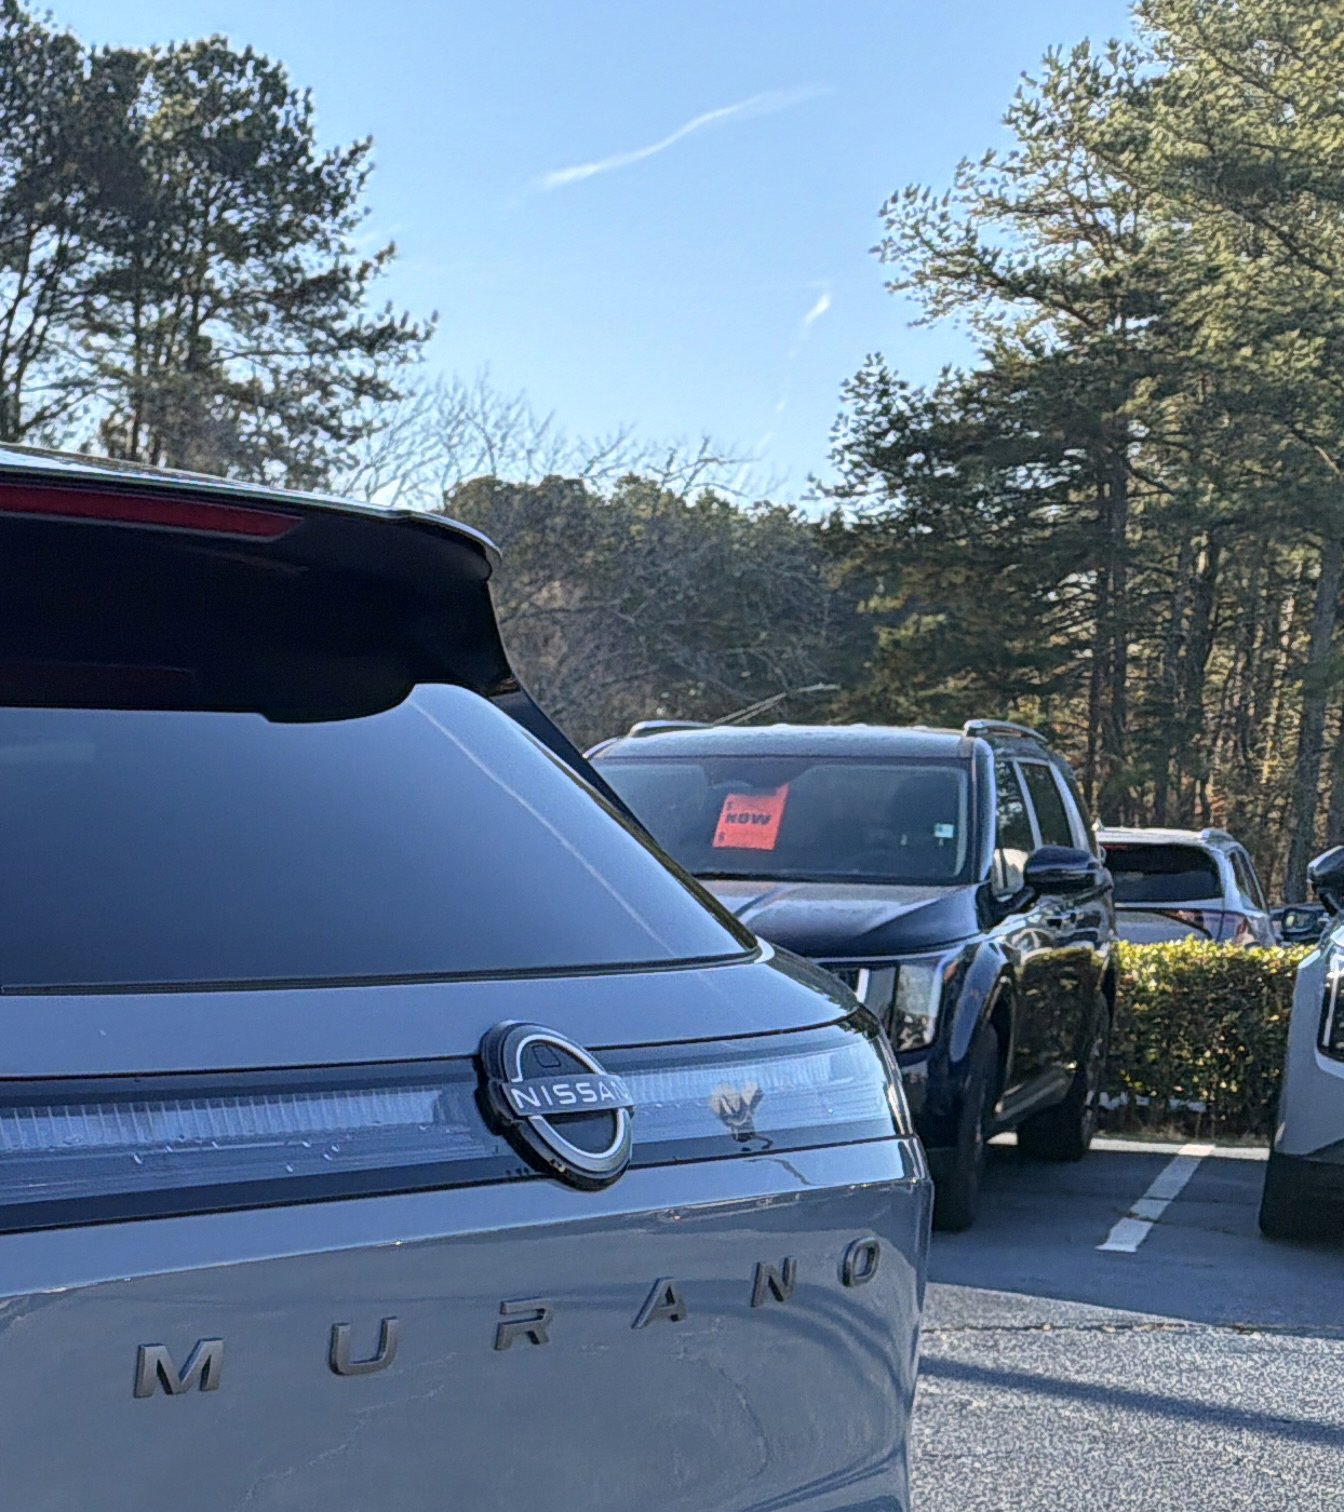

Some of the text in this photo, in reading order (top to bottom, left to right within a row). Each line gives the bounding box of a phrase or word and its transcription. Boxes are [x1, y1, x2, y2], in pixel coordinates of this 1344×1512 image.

[725, 812, 772, 825] NOW
[511, 1080, 631, 1109] NISSAN
[133, 1236, 881, 1399] MURANO
